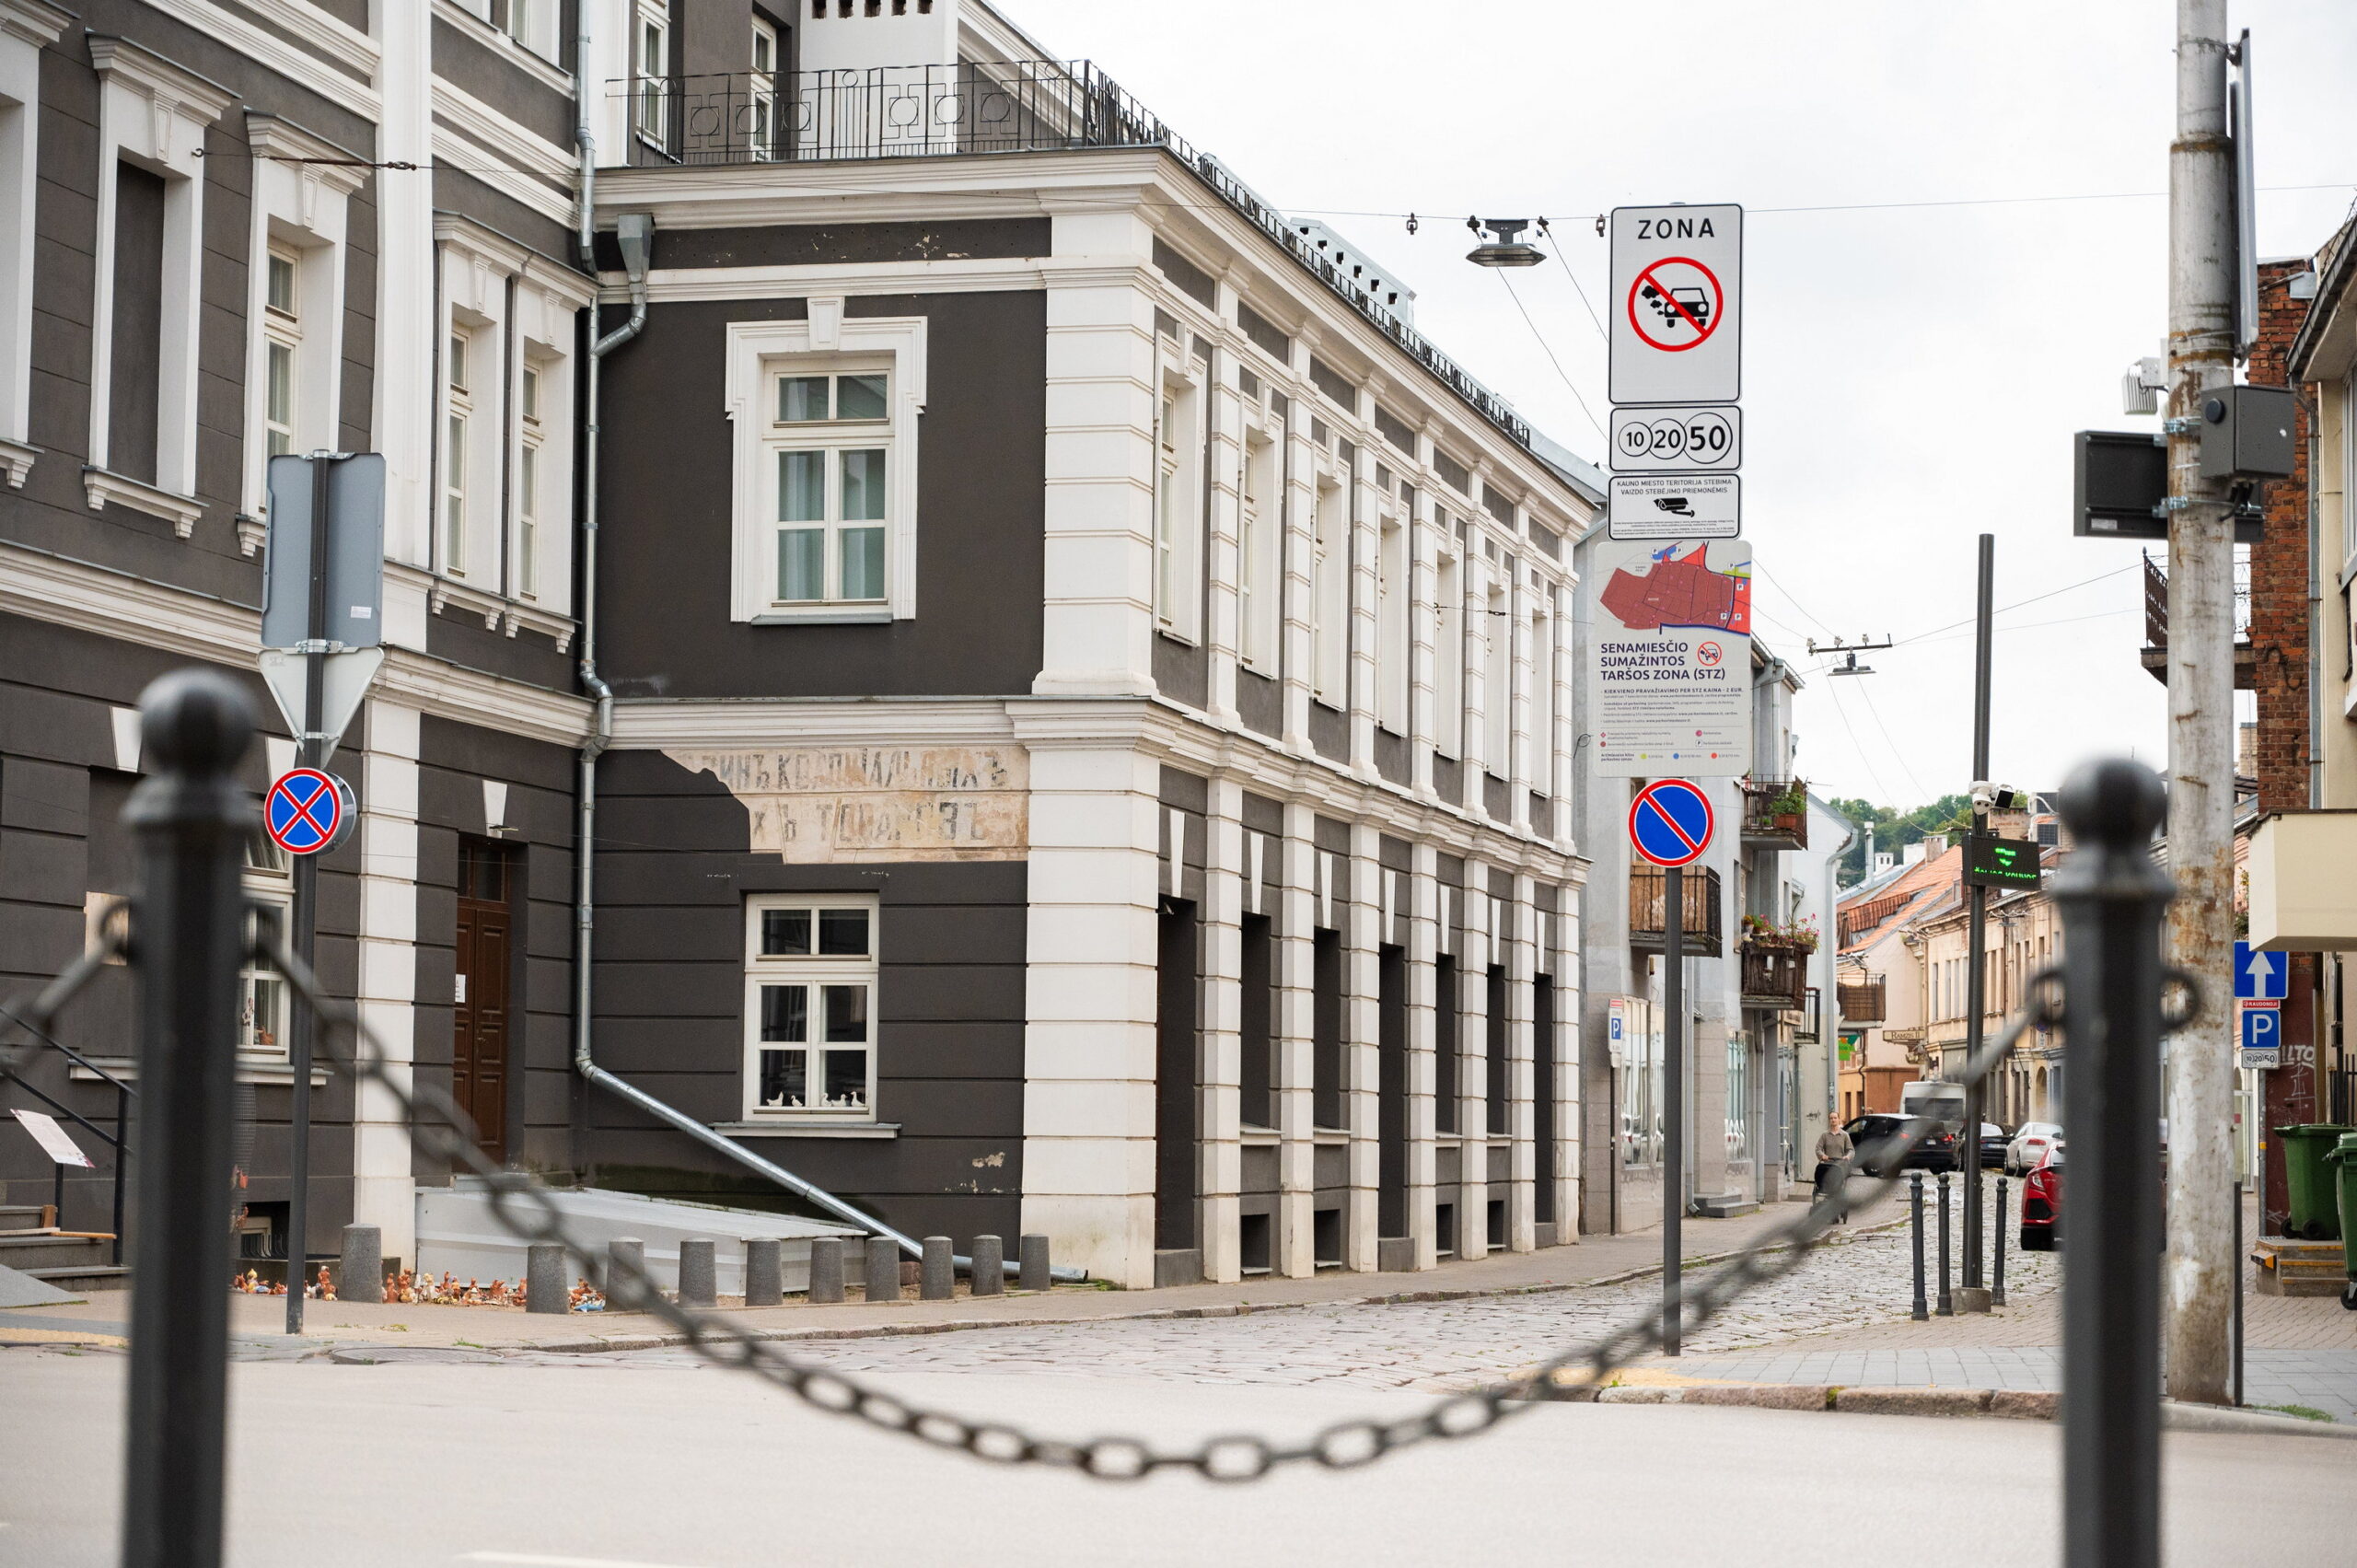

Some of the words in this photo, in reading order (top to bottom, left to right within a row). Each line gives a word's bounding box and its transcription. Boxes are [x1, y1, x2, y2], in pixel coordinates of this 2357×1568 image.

[1637, 217, 1715, 239] ZONA
[1626, 432, 1644, 447] 10
[1654, 429, 1681, 449] 20
[1689, 425, 1726, 451] 50
[1645, 487, 1681, 495] STEBĖJIMO
[1682, 486, 1728, 494] PRIEMONĖMIS
[1601, 640, 1688, 653] SENAMIESČIO
[1601, 654, 1685, 667] SUMAŽINTOS
[1601, 668, 1650, 680] TARŠOS
[1654, 669, 1689, 680] ZONA
[1693, 668, 1725, 680] (STZ)
[1613, 1020, 1620, 1038] P
[2252, 1014, 2272, 1044] P
